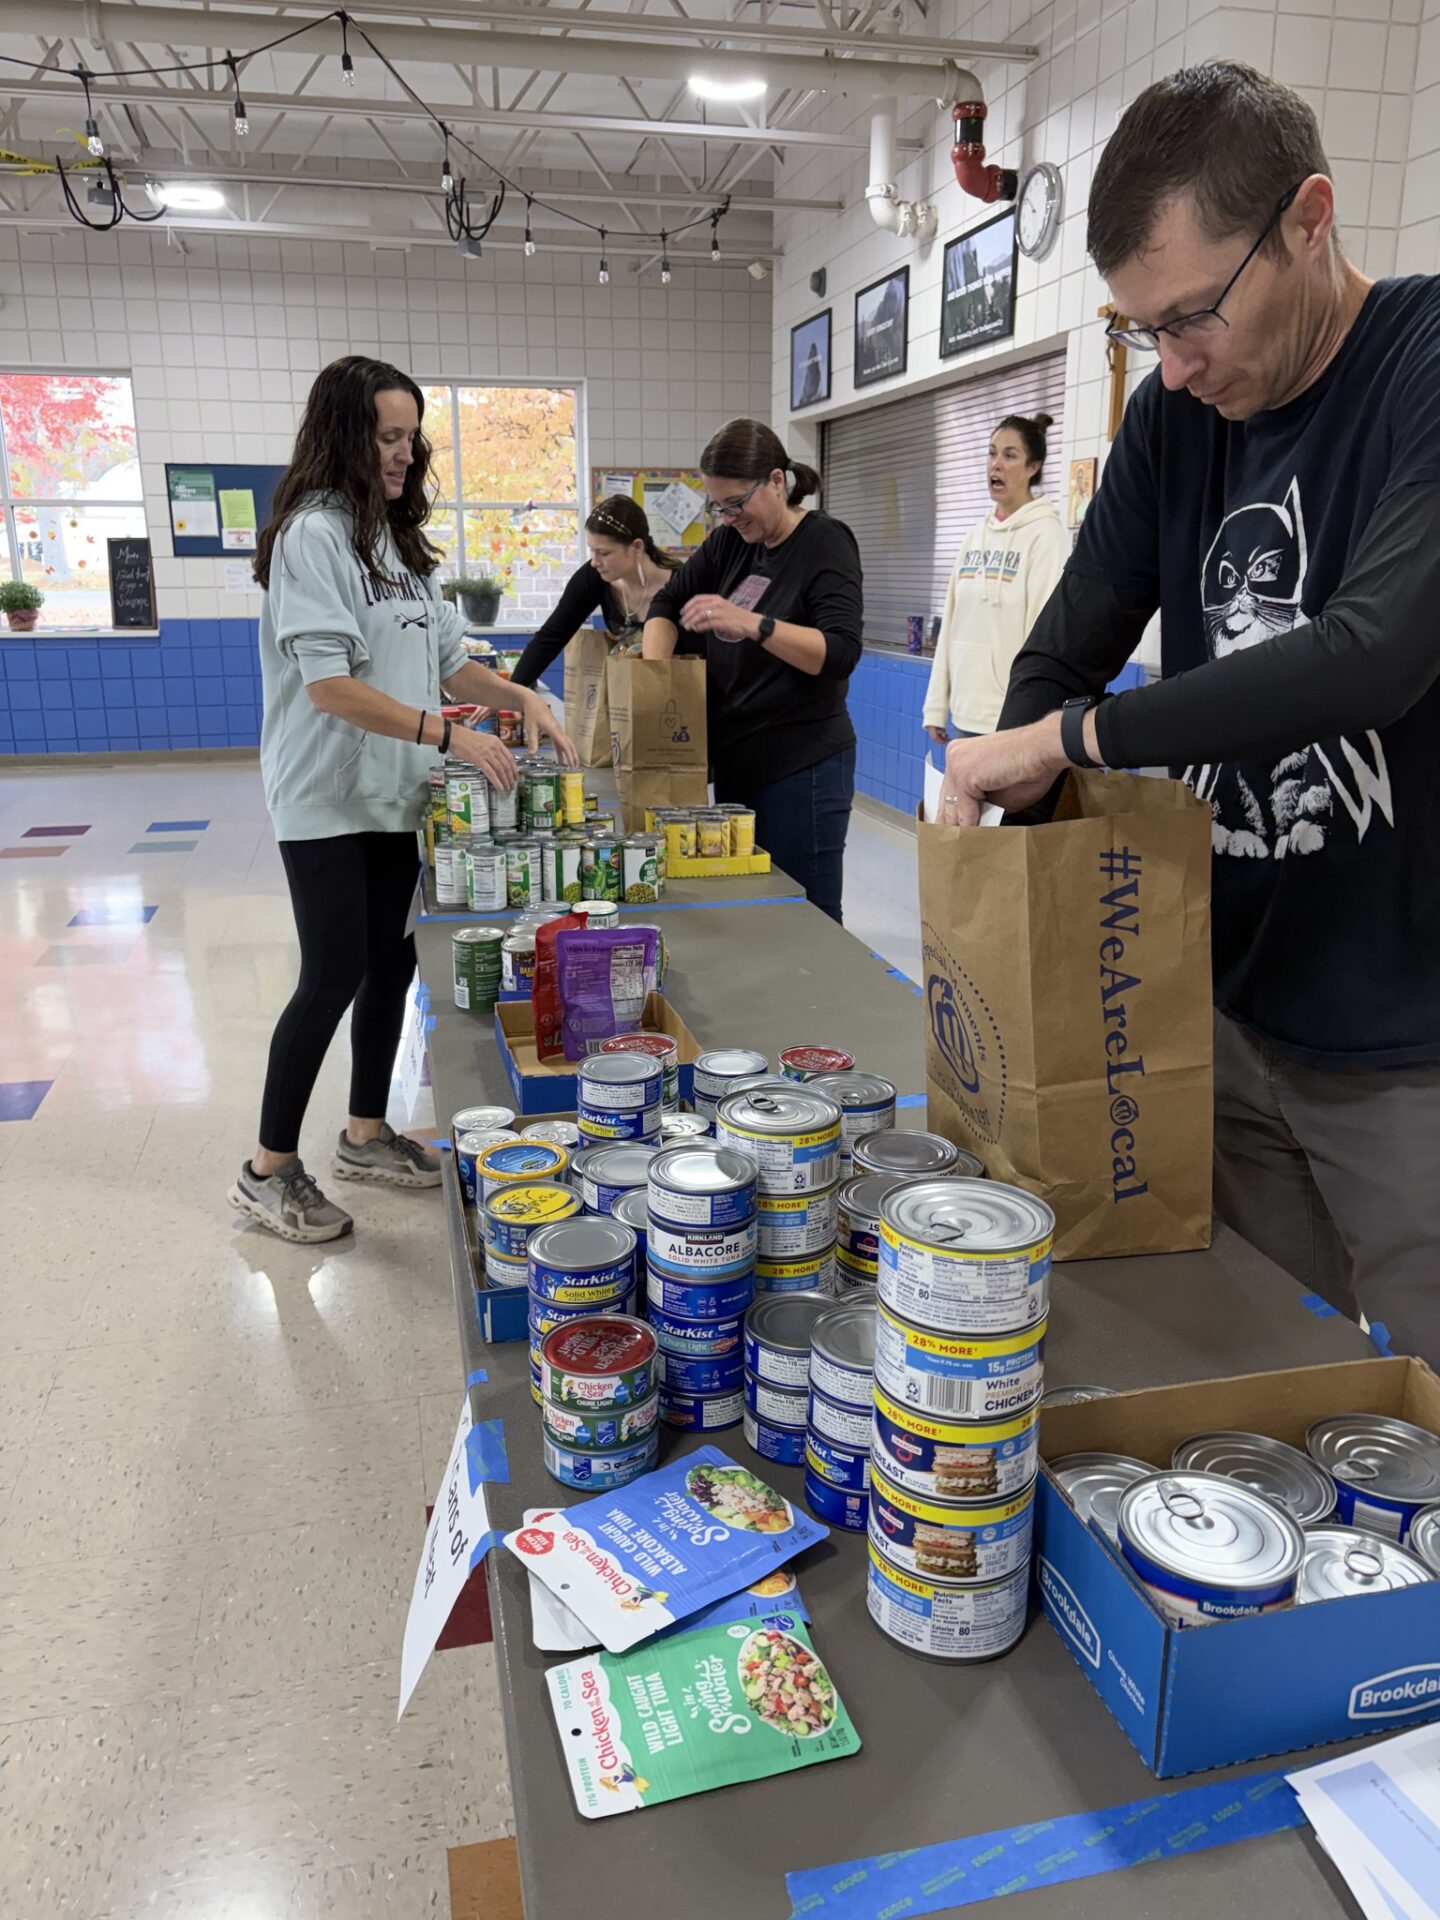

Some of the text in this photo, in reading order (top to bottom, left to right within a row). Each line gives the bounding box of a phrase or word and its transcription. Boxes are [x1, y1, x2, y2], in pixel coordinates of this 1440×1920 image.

[581, 1110, 617, 1125] StarKist
[687, 1233, 723, 1241] KIRKLAND
[668, 1254, 690, 1263] SOLID
[721, 1254, 740, 1263] TUNA
[669, 1242, 740, 1257] ALBACORE
[563, 1271, 614, 1287] StarKist
[772, 1266, 791, 1275] 28%
[564, 1287, 610, 1298] Solid White
[918, 1288, 930, 1300] 80
[663, 1321, 715, 1339] StarKist
[688, 1342, 707, 1351] Light
[912, 1335, 936, 1349] 28%
[578, 1381, 613, 1391] Chicken
[986, 1377, 1020, 1390] White
[586, 1390, 604, 1398] Sea
[985, 1386, 1034, 1411] CHICKEN
[664, 1491, 704, 1528] Water
[658, 1498, 731, 1546] Spring
[522, 1533, 545, 1553] RECIPE
[562, 1531, 586, 1552] Sea
[598, 1523, 663, 1577] WILD CAUGHT
[606, 1509, 688, 1576] ALBACORE TUNA
[586, 1552, 633, 1596] Chicken
[934, 1590, 965, 1599] Nutrition
[934, 1597, 952, 1605] Facts
[1041, 1566, 1093, 1648] Brookdale
[1202, 1602, 1259, 1617] Brookdale
[959, 1626, 970, 1636] 80
[581, 1670, 600, 1700] Sea
[710, 1654, 733, 1719] Water
[1360, 1676, 1440, 1708] Brookdal
[696, 1660, 752, 1734] Spring
[1119, 1676, 1145, 1716] Chicken
[563, 1701, 574, 1710] 70
[626, 1674, 666, 1755] WILD CAUGHT
[645, 1671, 684, 1746] LIGHT TUNA
[591, 1706, 619, 1771] Chicken
[578, 1758, 594, 1793] PROTEIN
